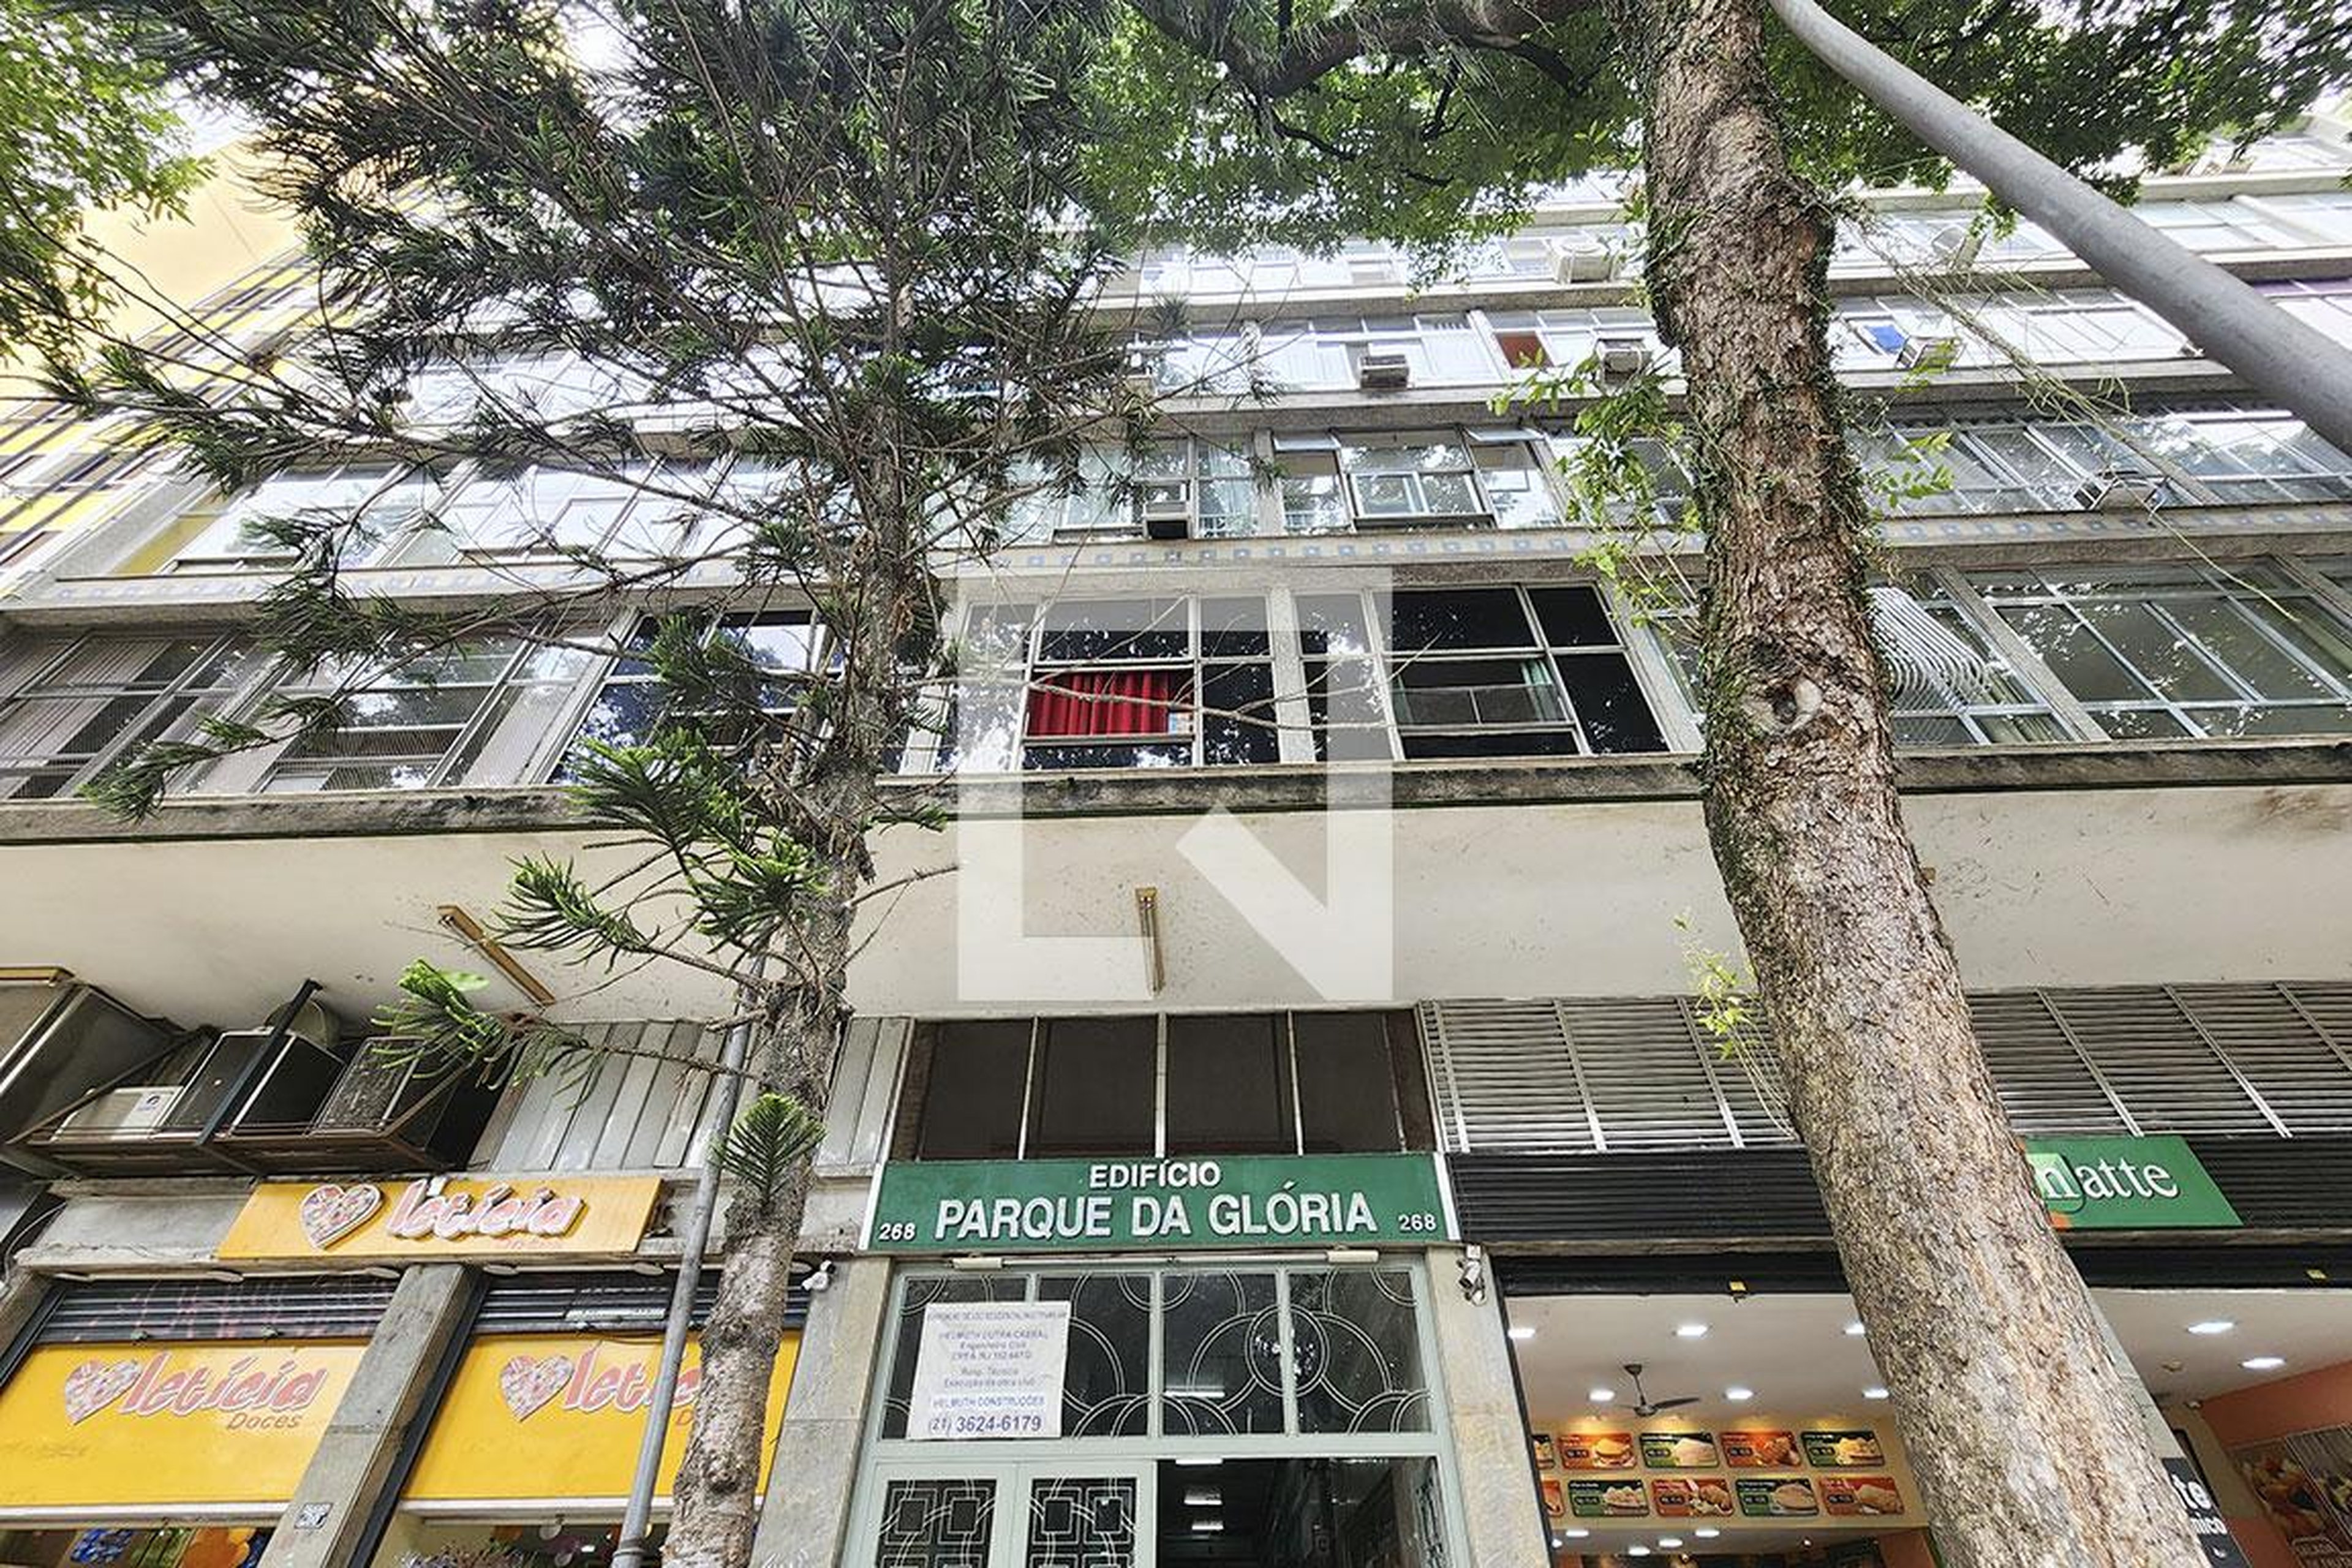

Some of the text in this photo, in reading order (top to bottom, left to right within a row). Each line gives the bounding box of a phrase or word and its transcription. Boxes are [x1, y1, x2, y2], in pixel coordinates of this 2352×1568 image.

[1090, 1159, 1222, 1188] EDIFÍCIO
[935, 1180, 1378, 1240] PARQUE DA GLÓRIA
[879, 1222, 916, 1241] 268
[1398, 1213, 1437, 1232] 268
[226, 1411, 303, 1431] Doces
[928, 1414, 1042, 1436] (21) 3624-6179
